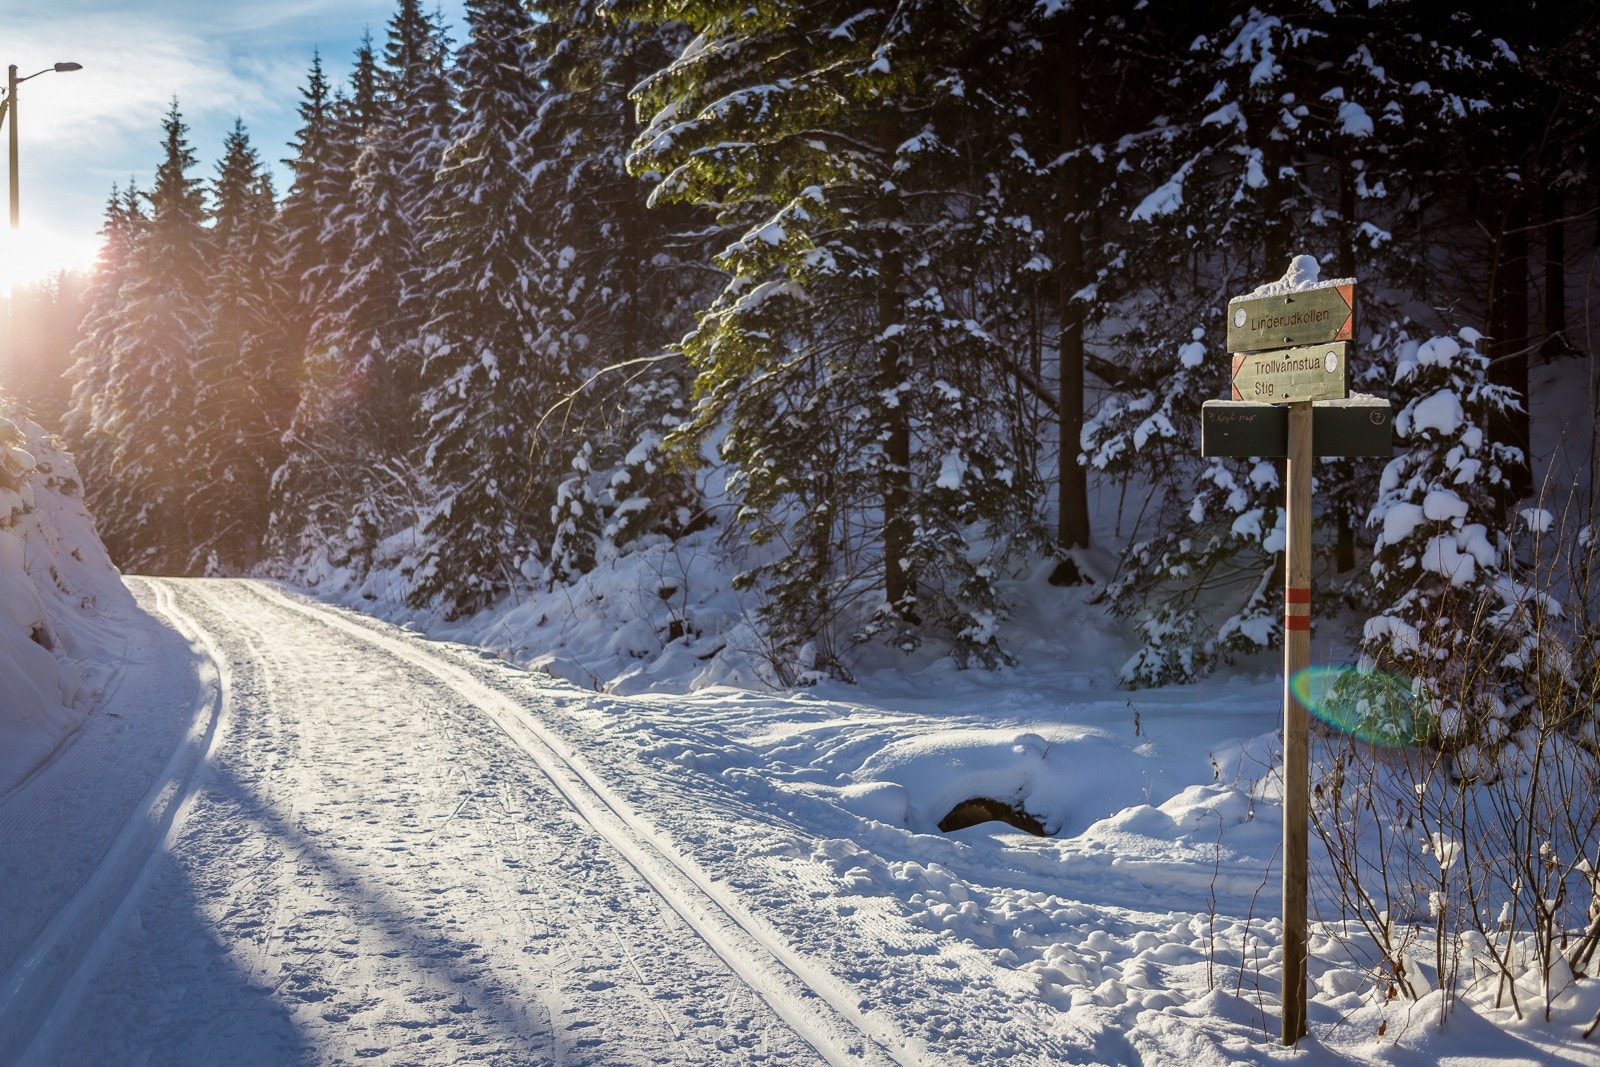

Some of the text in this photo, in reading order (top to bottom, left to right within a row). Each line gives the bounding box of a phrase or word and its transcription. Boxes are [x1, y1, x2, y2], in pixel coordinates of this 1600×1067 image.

[1251, 309, 1330, 331] Linderudkollen
[1255, 357, 1321, 375] Trollvannstua
[1254, 381, 1274, 396] Stig
